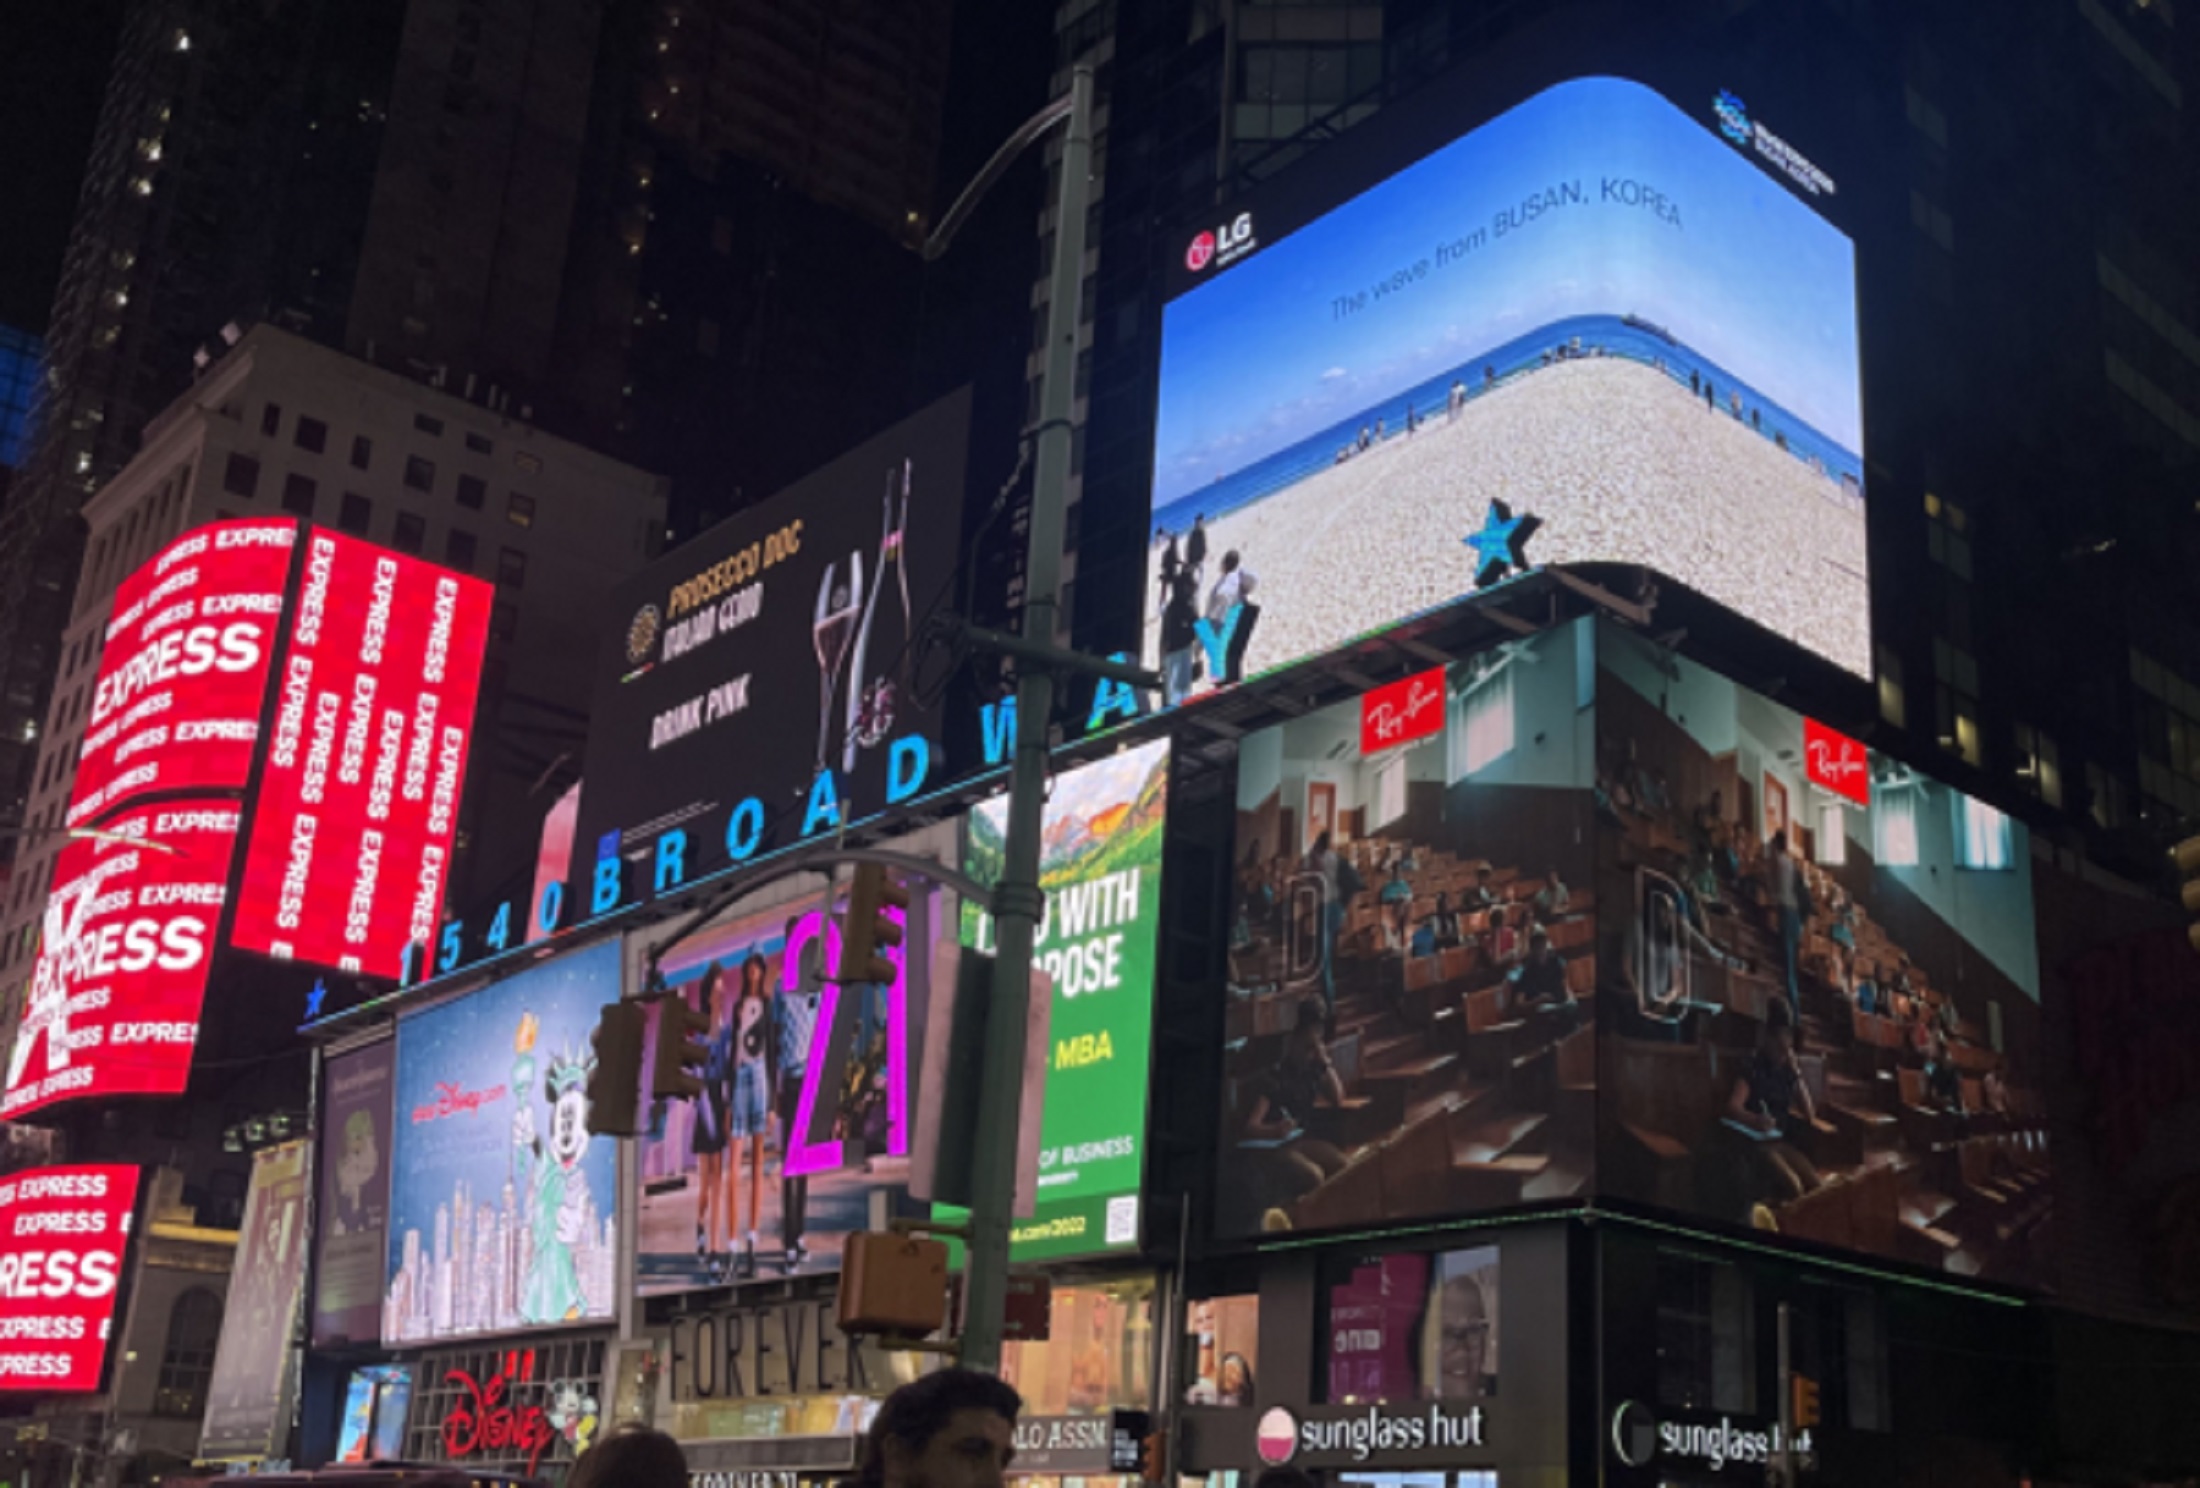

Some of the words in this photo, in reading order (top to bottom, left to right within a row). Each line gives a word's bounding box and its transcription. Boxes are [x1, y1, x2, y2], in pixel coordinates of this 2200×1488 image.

[1217, 212, 1251, 251] LG
[1331, 291, 1368, 320] The
[1372, 257, 1430, 302] wave
[1434, 226, 1488, 269] from
[1494, 179, 1590, 239] BUSAN,
[1601, 176, 1683, 230] KOREA
[215, 526, 298, 549] EXPRE
[666, 542, 761, 621] PROSECCO
[763, 517, 804, 570] DOC
[201, 593, 283, 618] EXPRE
[296, 536, 335, 646] EXPRESS
[358, 556, 398, 666] EXPRESS
[422, 576, 459, 684] EXPRESS
[92, 622, 262, 725] EXPRESS
[272, 655, 314, 769] EXPRESS
[174, 719, 260, 742] EXPRE
[300, 690, 341, 804] EXPRESS
[337, 673, 377, 785] EXPRESS
[366, 708, 405, 821] EXPRESS
[402, 692, 440, 800] EXPRESS
[427, 726, 464, 834] EXPRESS
[154, 810, 241, 834] EXPRE
[275, 813, 318, 930] EXPRESS
[344, 828, 384, 944] EXPRESS
[1060, 866, 1139, 938] WITH
[782, 906, 907, 1178] 21
[1055, 1029, 1113, 1069] MBA
[18, 1175, 108, 1199] EXPRESS
[1062, 1134, 1134, 1166] BUSINESS
[14, 1212, 108, 1236] EXPRESS
[670, 1300, 867, 1403] FOREVER
[1301, 1408, 1425, 1460] sunglass
[1430, 1404, 1482, 1447] hut
[1659, 1416, 1769, 1472] sunglass
